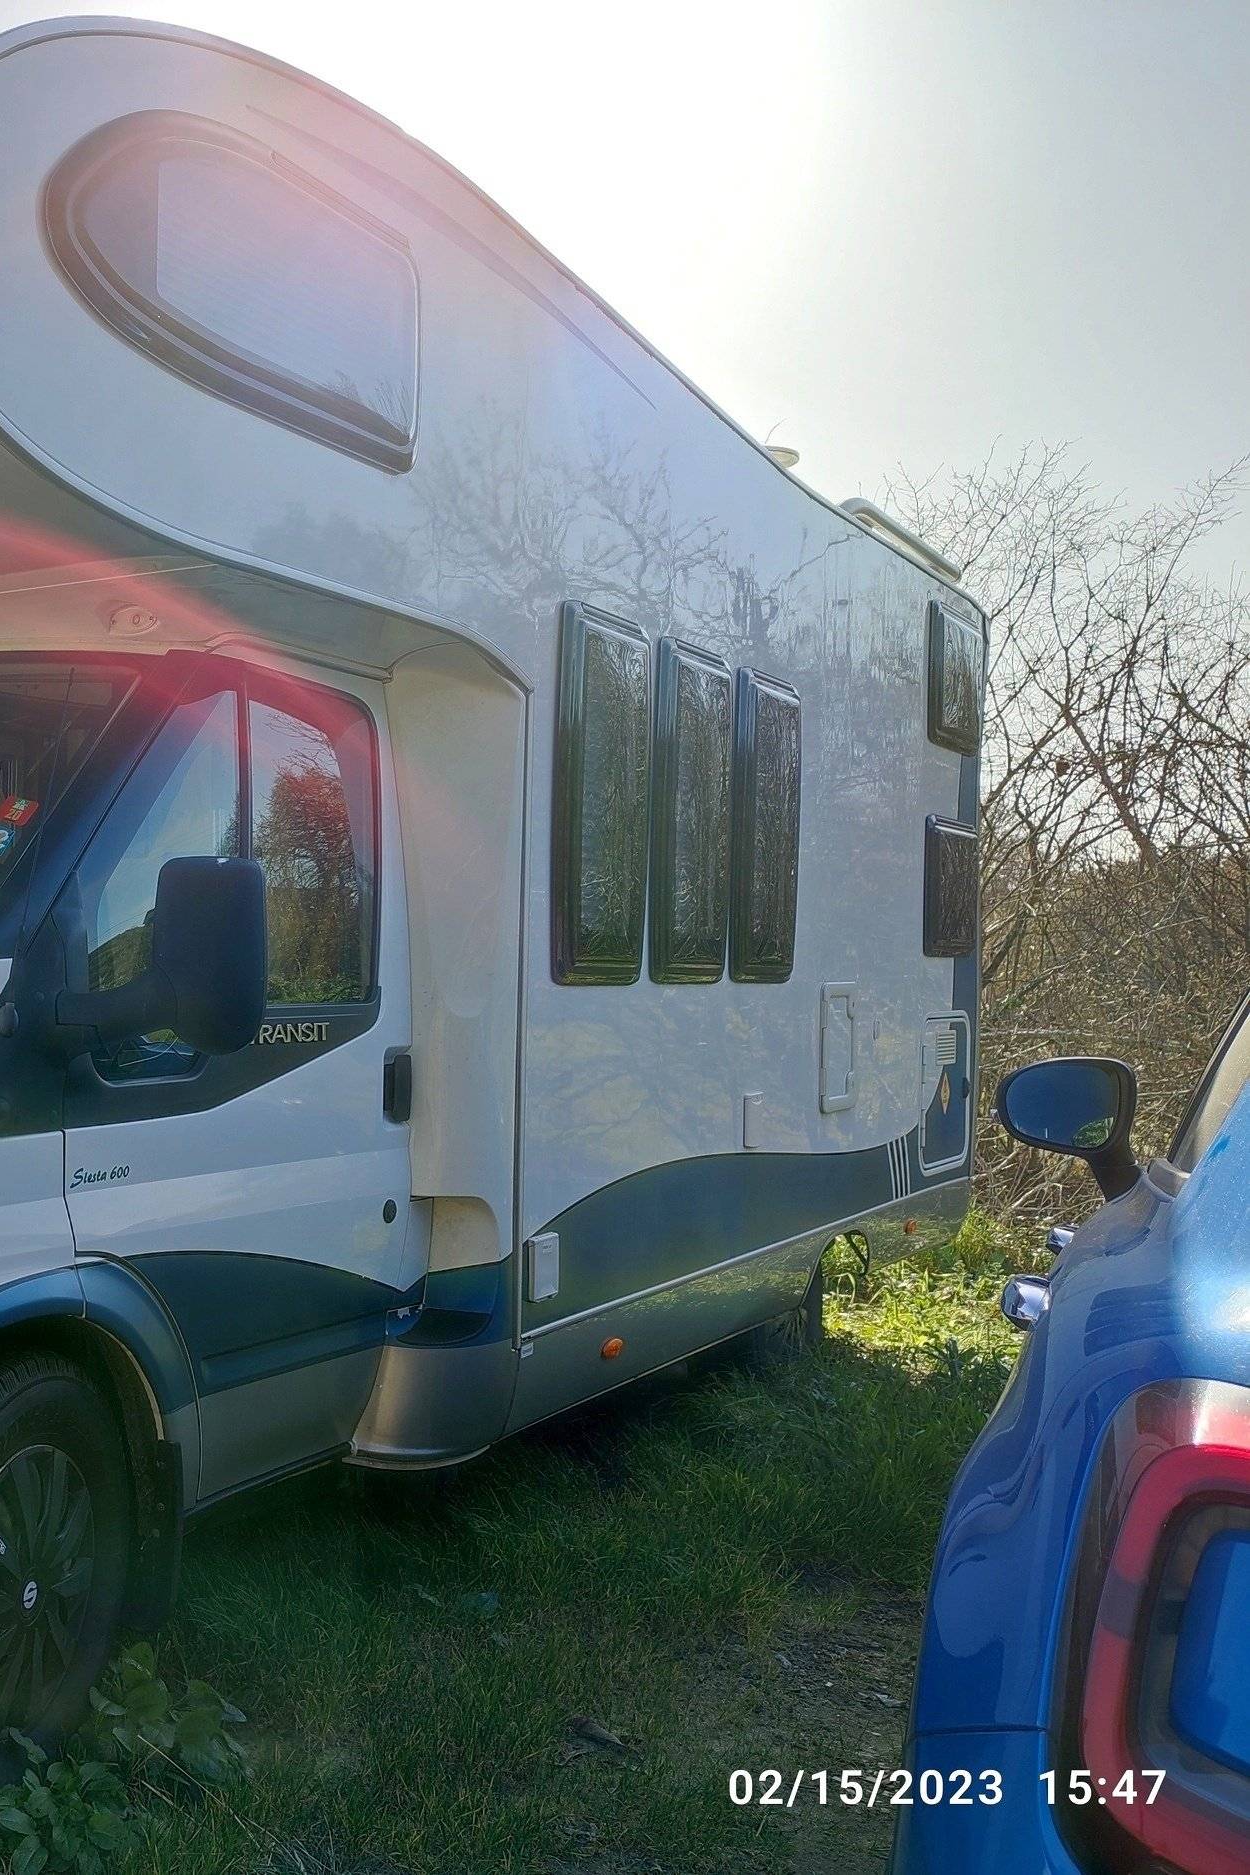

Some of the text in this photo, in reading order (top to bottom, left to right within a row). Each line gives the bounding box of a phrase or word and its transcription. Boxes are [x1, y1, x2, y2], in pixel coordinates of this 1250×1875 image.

[250, 1022, 330, 1045] RANSIT
[70, 1165, 130, 1188] Siesta 600
